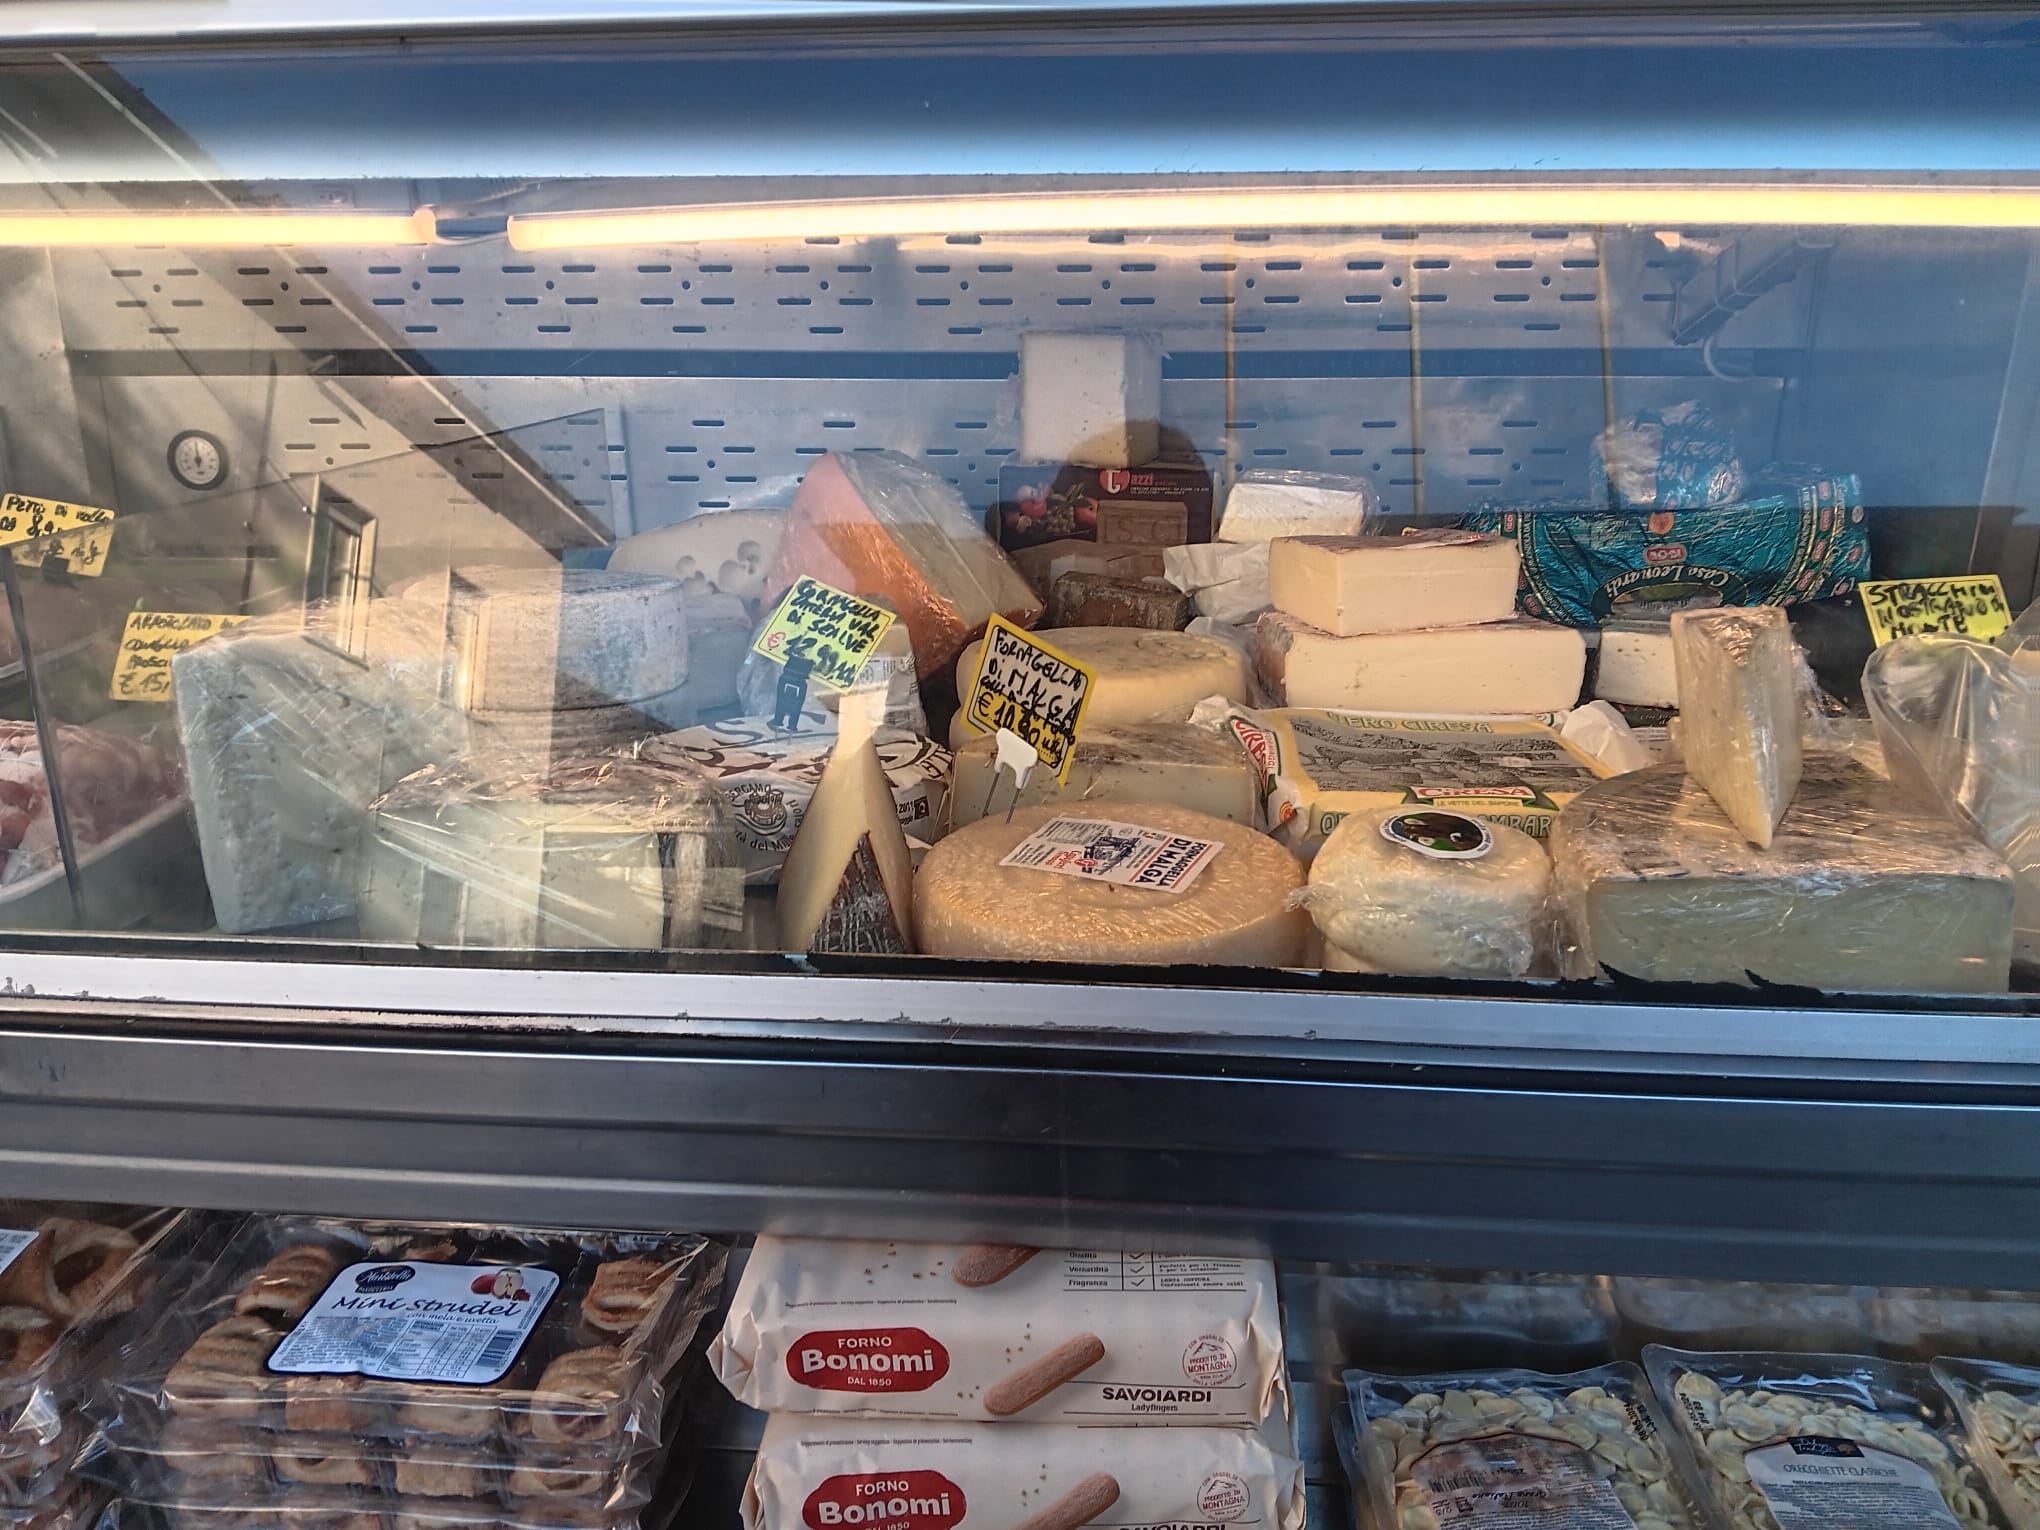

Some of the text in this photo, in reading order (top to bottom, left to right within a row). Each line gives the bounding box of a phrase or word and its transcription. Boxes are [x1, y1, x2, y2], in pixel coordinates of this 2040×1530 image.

[1603, 565, 1685, 597] Leonardi
[978, 691, 994, 717] €
[1401, 718, 1496, 733] CIRESA
[1135, 850, 1176, 884] MALGA
[1069, 1279, 1107, 1287] Fragranza
[331, 1295, 522, 1317] Mini strudel
[838, 1337, 892, 1349] FORNO
[801, 1349, 934, 1374] Bonomi
[1188, 1361, 1232, 1373] MONTAGNA
[848, 1377, 892, 1386] DAL 1850
[1102, 1387, 1211, 1402] SAVOIARDI
[1131, 1403, 1178, 1413] Ladyfingers
[855, 1480, 909, 1496] FORNO
[818, 1492, 951, 1525] Bonomi
[1202, 1495, 1246, 1510] MONTAGNA
